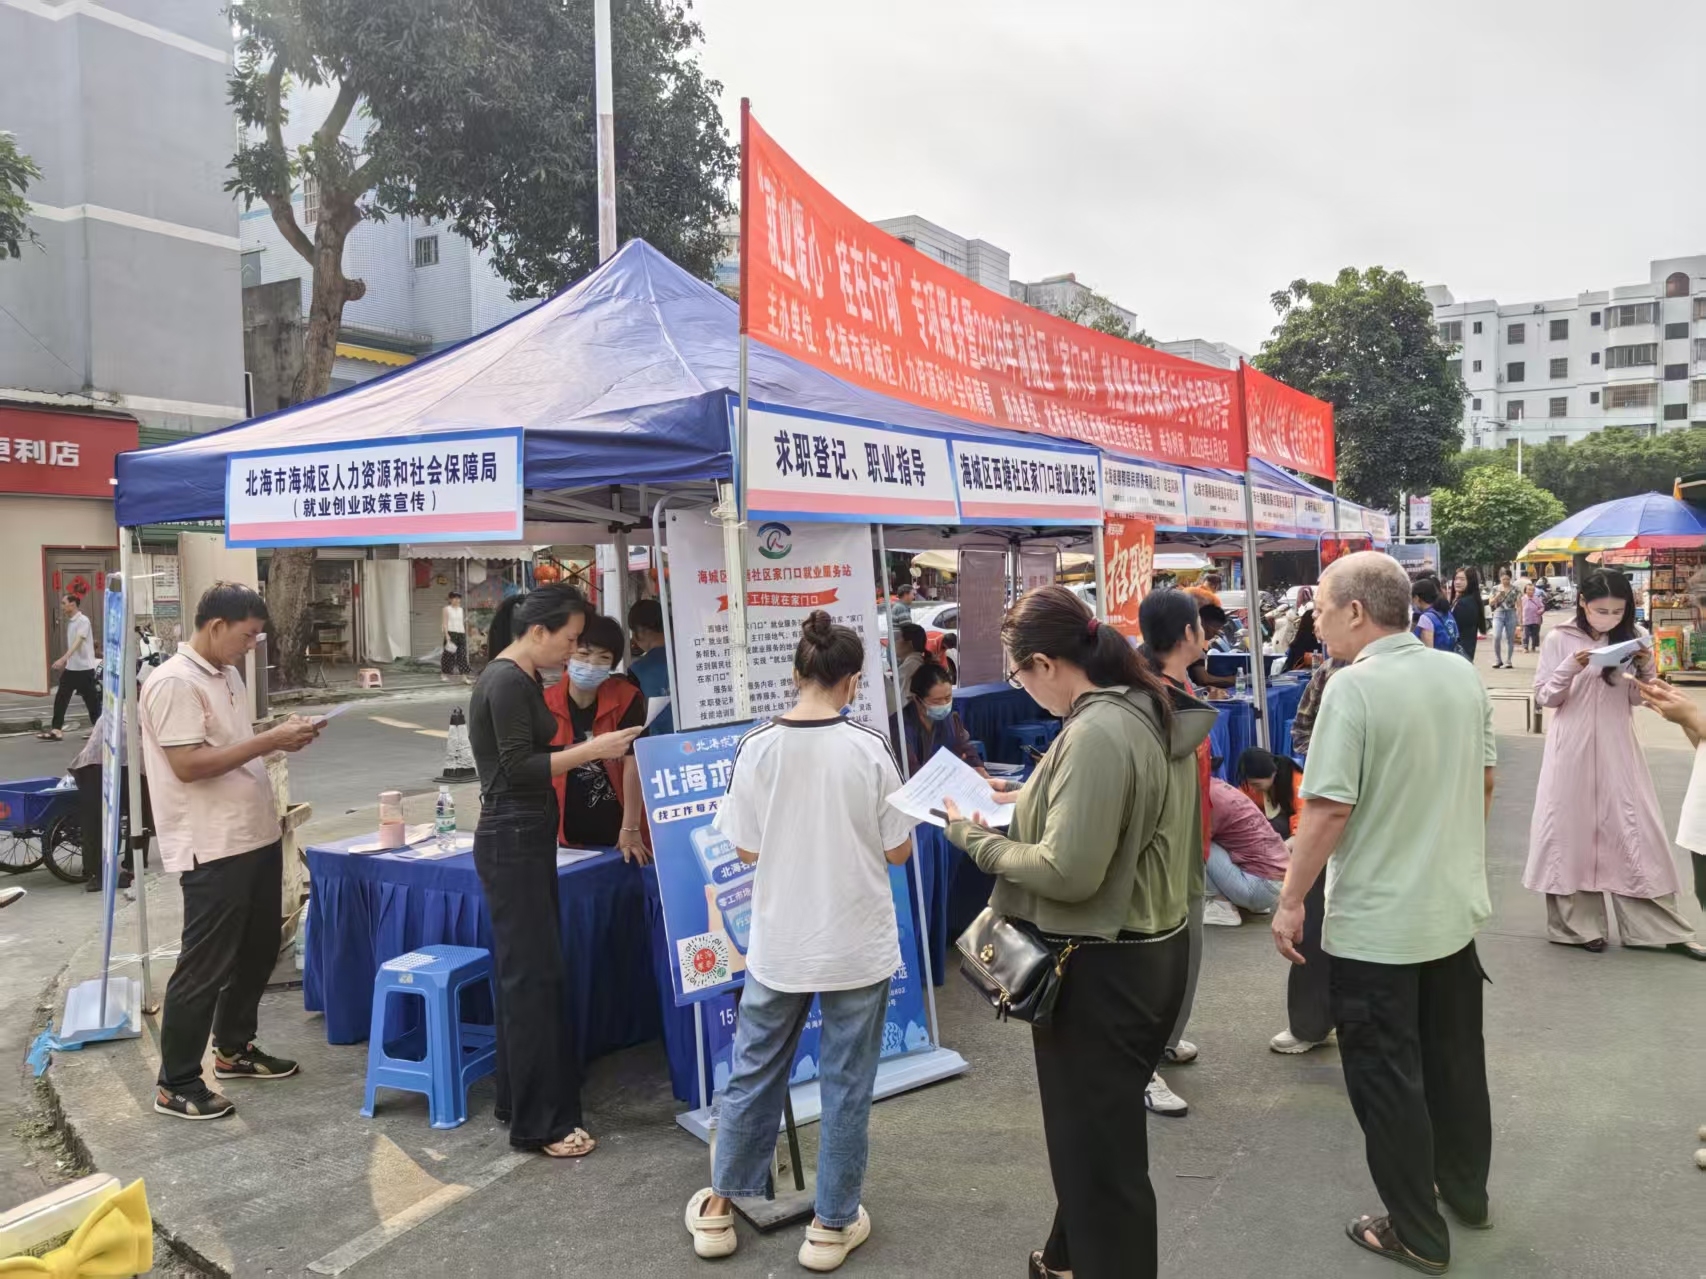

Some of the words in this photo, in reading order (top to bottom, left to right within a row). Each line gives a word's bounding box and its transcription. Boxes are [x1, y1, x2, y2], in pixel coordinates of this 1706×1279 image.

[245, 451, 497, 497] 北海市海城区人力资源和社会保障局
[774, 429, 926, 487] 求职登记、职业指导
[959, 452, 1097, 497] 海城区西塘社区家门口就业服务站
[293, 490, 436, 518] （就业创业政策宣传）
[1106, 533, 1153, 614] 招聘
